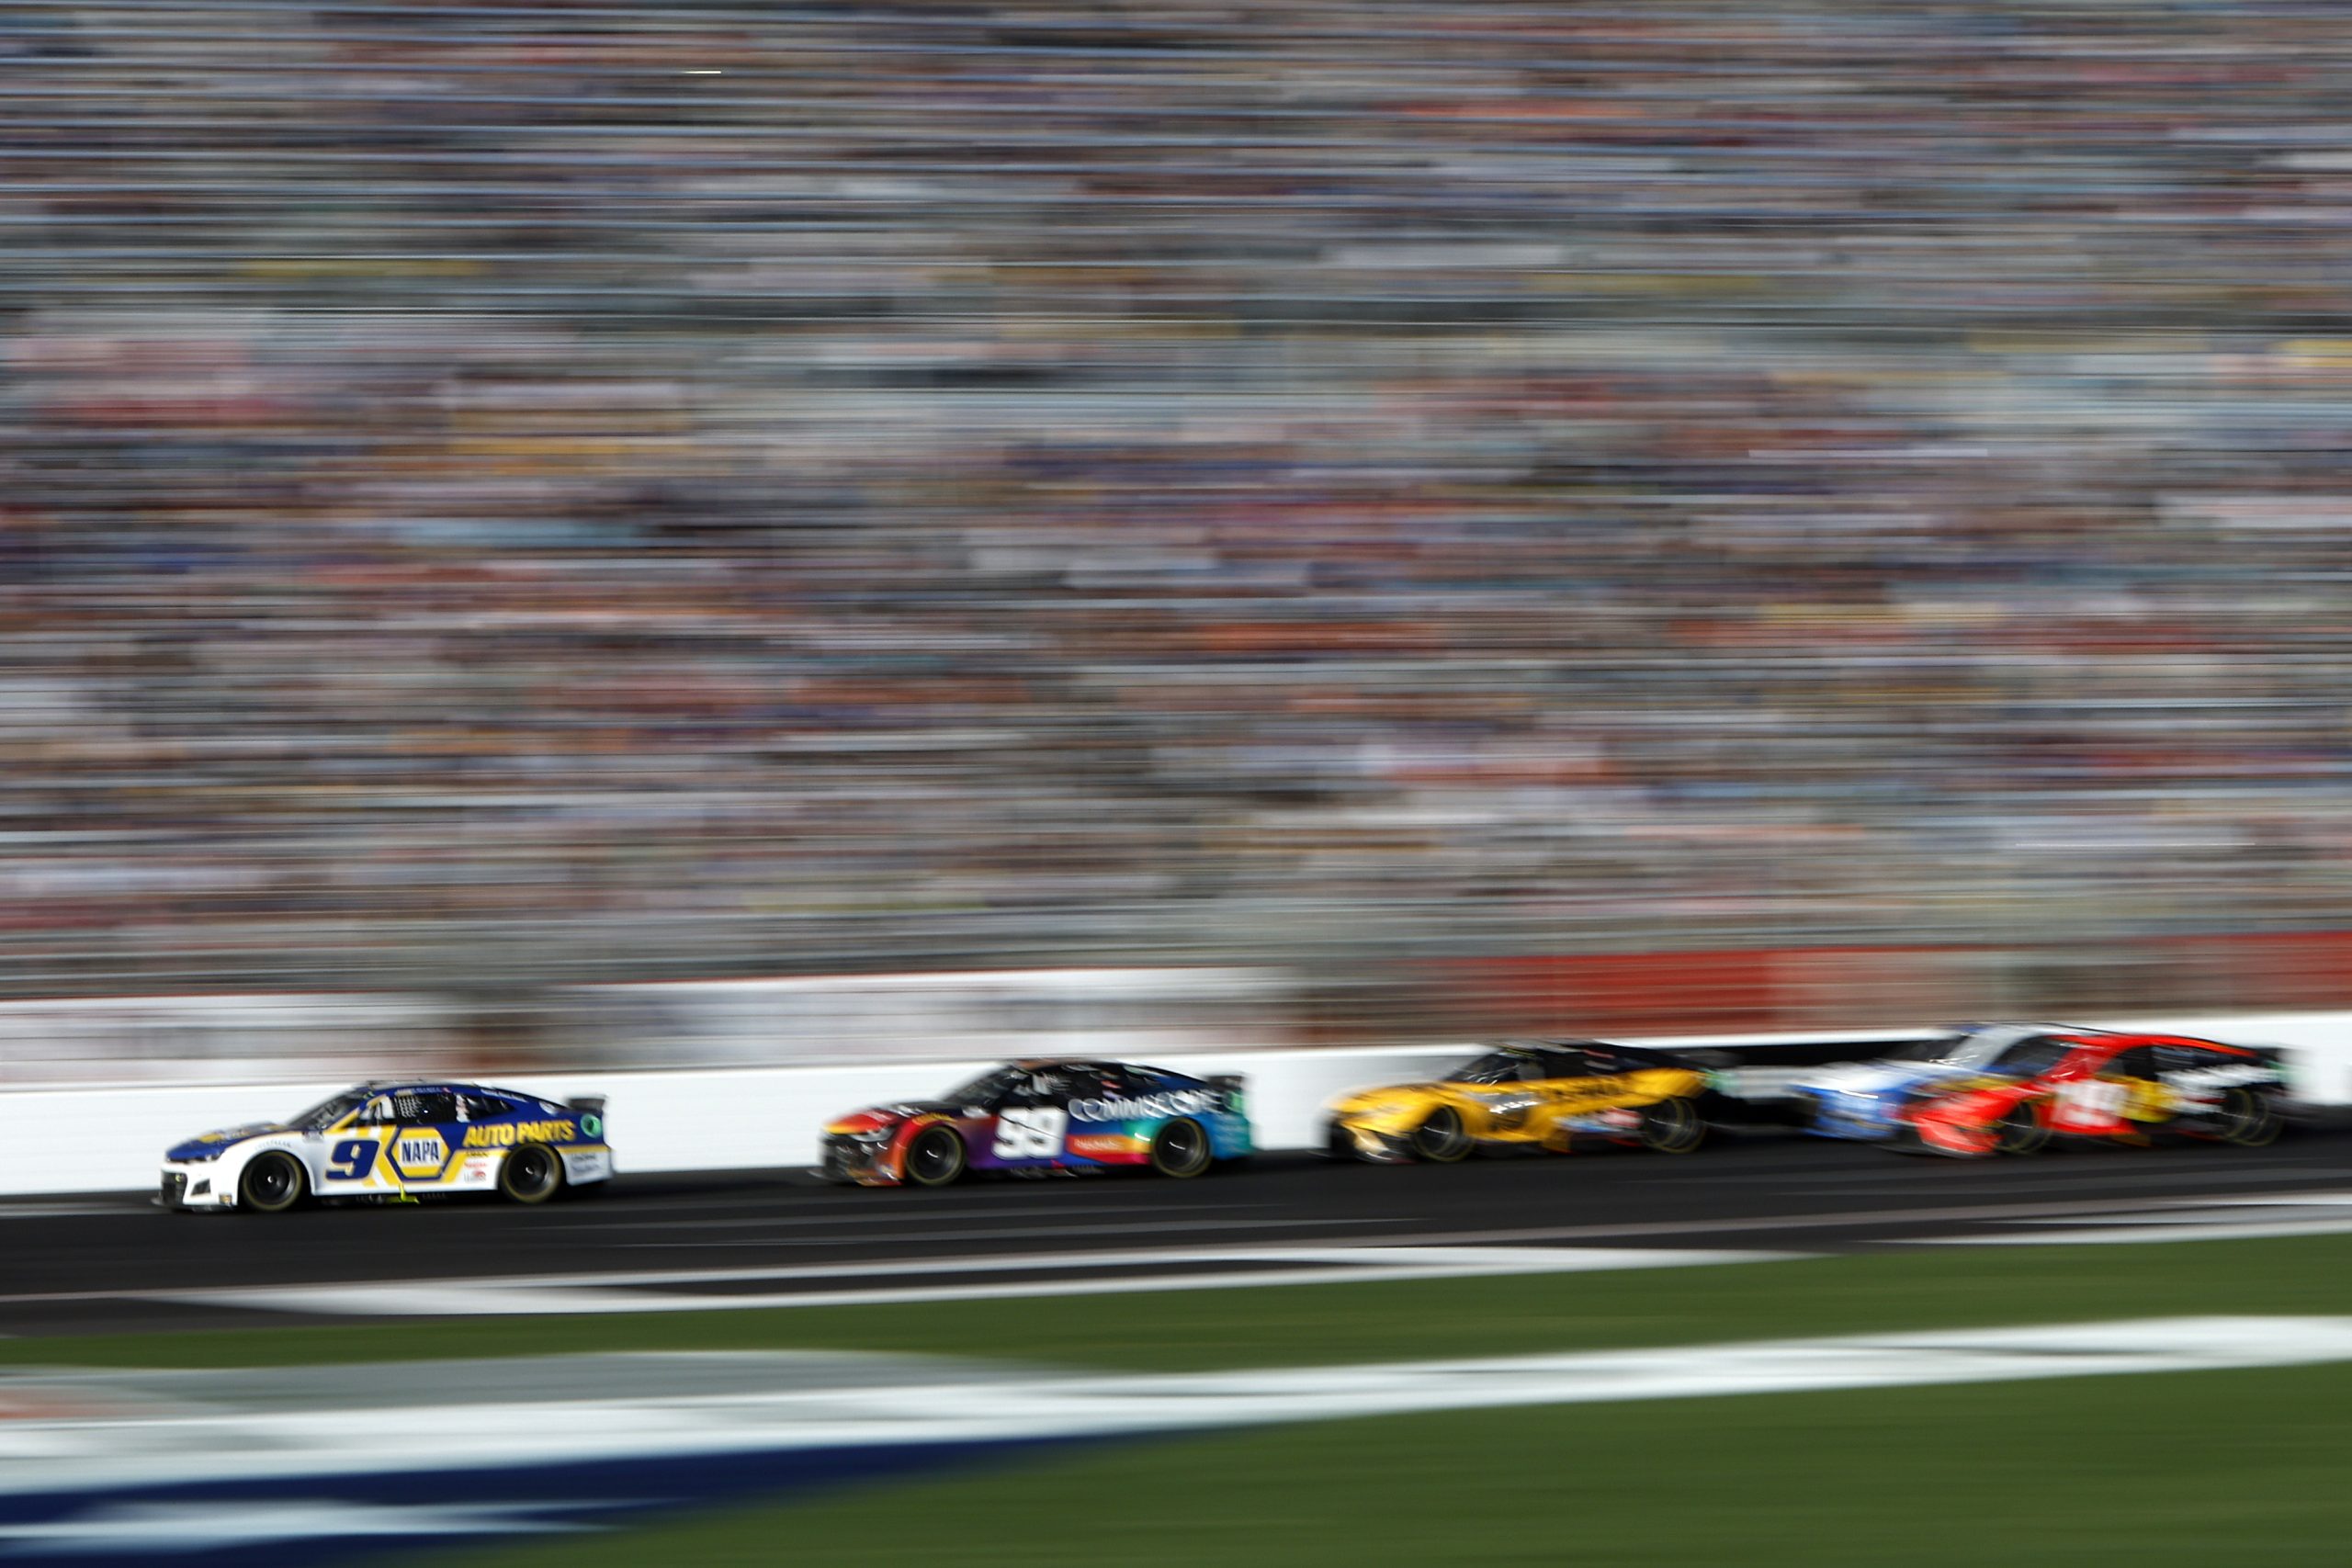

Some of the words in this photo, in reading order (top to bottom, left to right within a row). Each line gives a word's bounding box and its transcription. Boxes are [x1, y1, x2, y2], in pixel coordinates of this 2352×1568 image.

[461, 1122, 515, 1147] AUTO
[516, 1118, 577, 1144] PARTS
[325, 1139, 380, 1180] 9
[401, 1140, 440, 1163] NAPA
